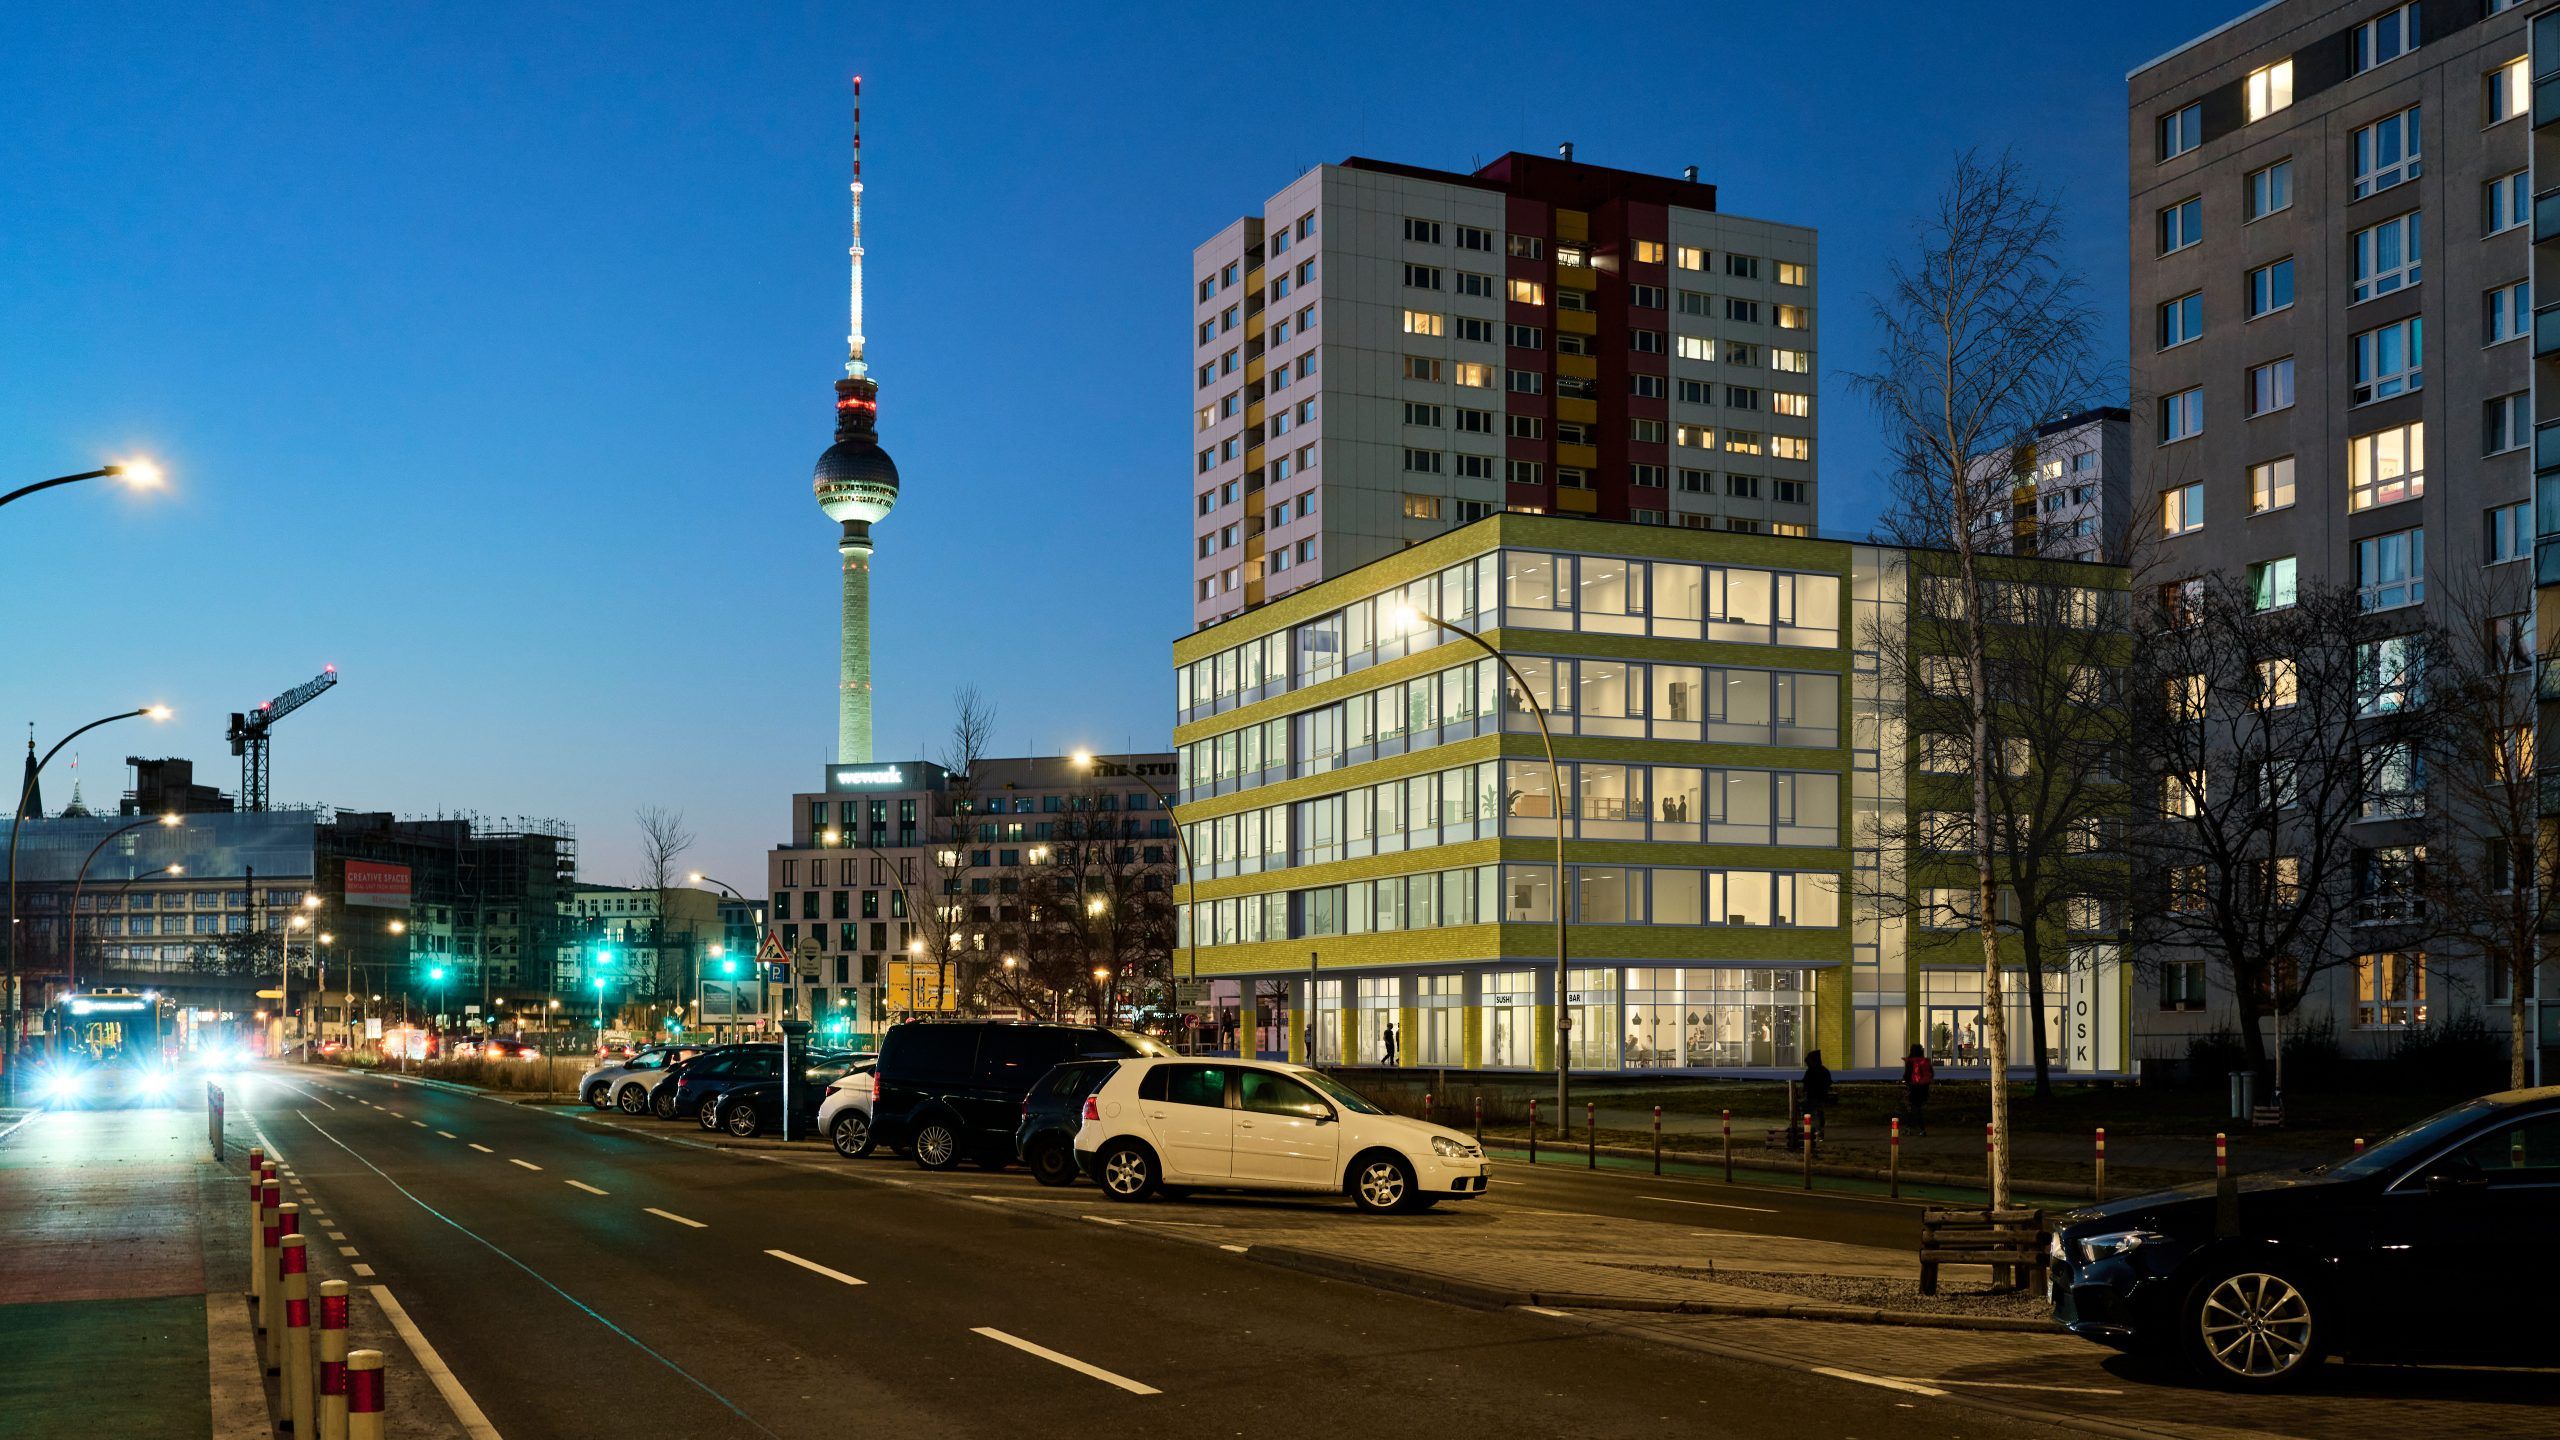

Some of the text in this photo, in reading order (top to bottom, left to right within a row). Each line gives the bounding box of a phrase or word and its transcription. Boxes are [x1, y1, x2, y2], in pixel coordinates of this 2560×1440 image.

[837, 765, 902, 784] wework
[1092, 764, 1128, 777] THE
[347, 872, 409, 884] CREATIVE SPACES
[1496, 994, 1581, 1004] SUSHI BAR
[2076, 955, 2088, 1061] KIOSK
